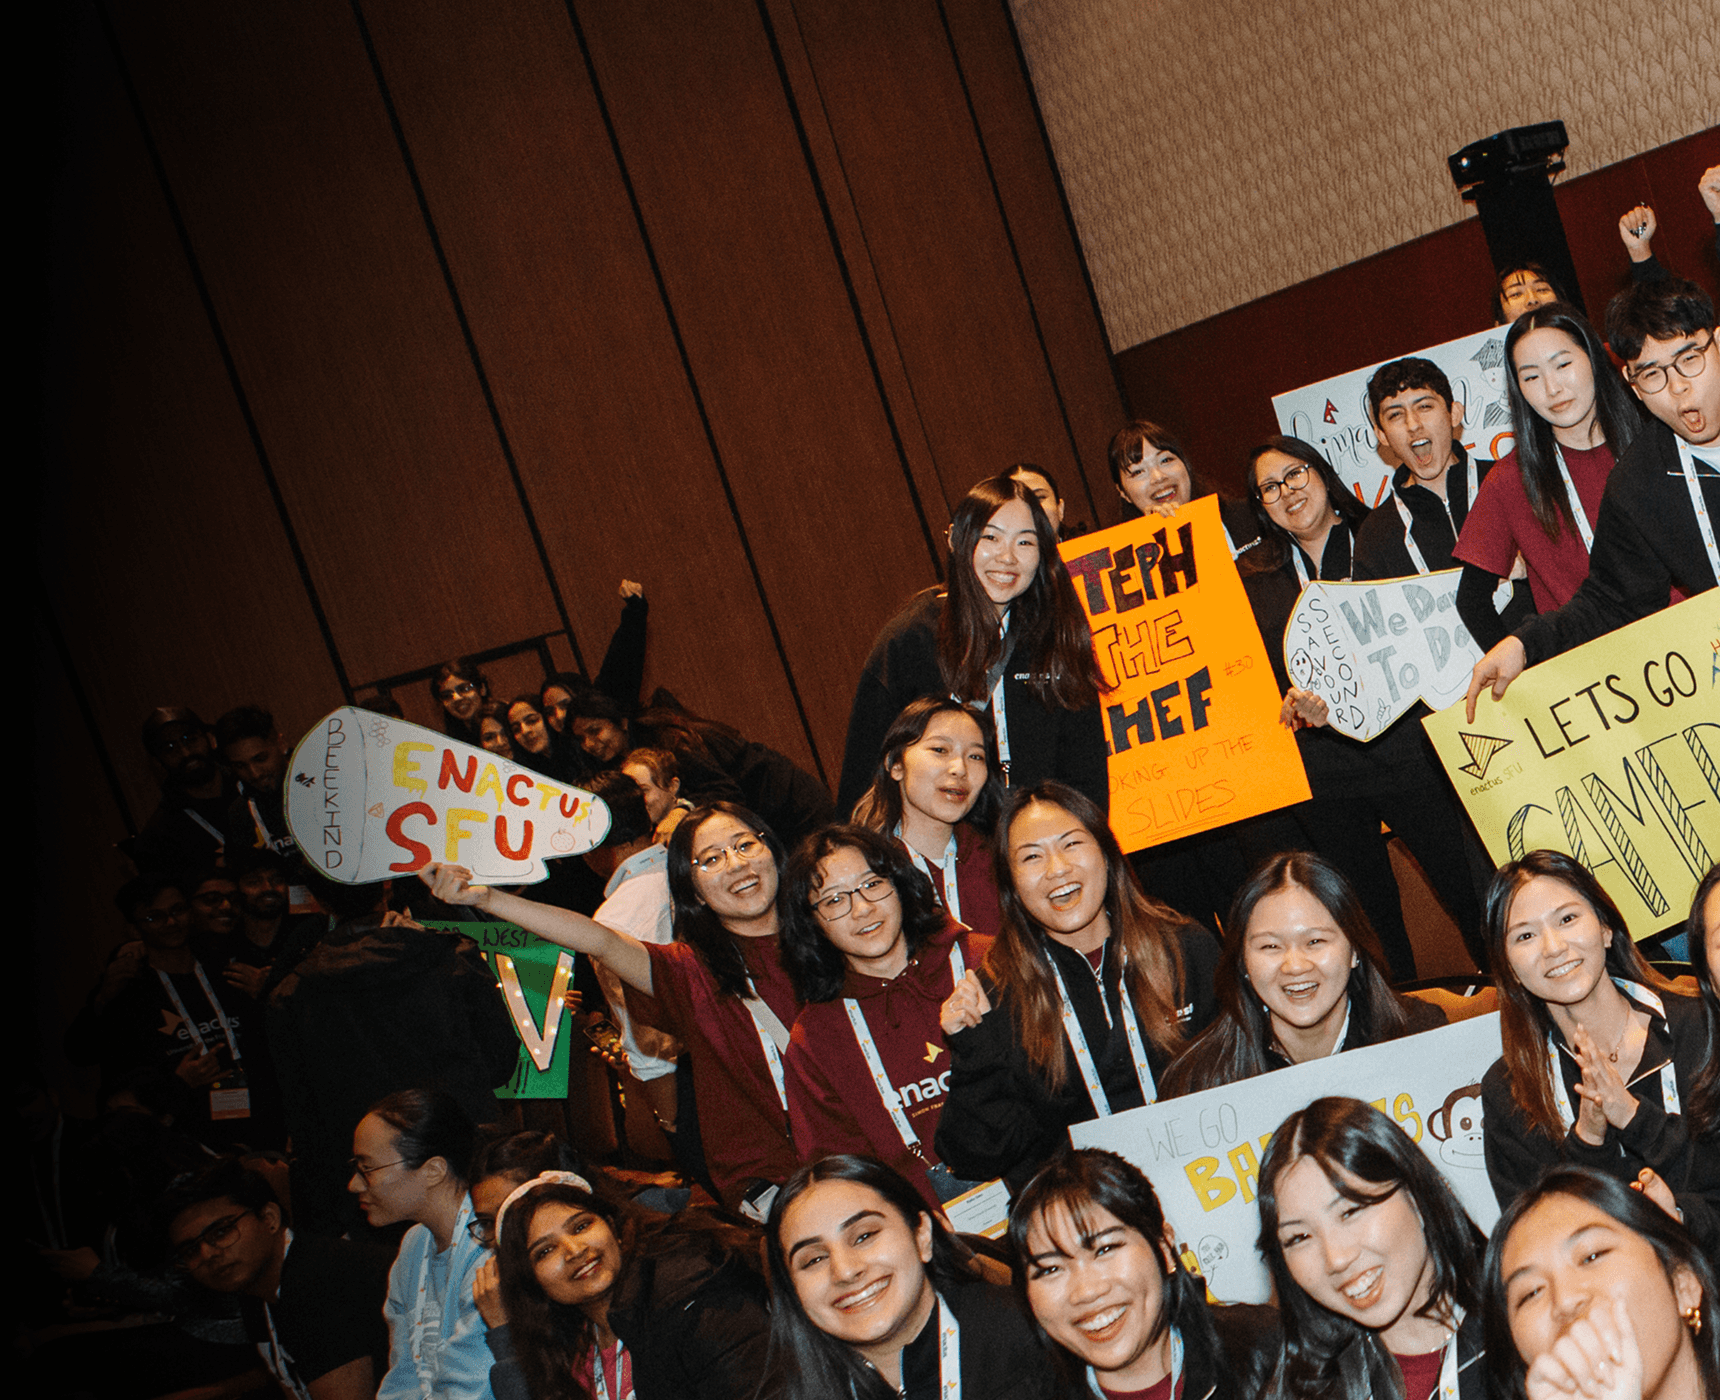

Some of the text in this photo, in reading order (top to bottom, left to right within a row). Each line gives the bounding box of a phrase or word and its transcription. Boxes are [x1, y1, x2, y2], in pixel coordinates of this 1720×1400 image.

[1066, 522, 1199, 616] TEPH
[1339, 584, 1457, 647] We Dar
[1092, 609, 1195, 696] THE
[1223, 655, 1253, 678] #30
[1308, 598, 1365, 730] SECOND
[1367, 645, 1420, 703] To
[1106, 666, 1213, 756] HEF
[1524, 651, 1698, 759] LETS GO
[393, 741, 591, 828] ENACTUS
[1110, 733, 1254, 795] OKING UP THE
[1470, 775, 1503, 796] enactus
[386, 801, 534, 872] SFU
[1127, 778, 1237, 837] SLIDES
[482, 927, 529, 947] WEST
[481, 950, 575, 1074] V
[1147, 1103, 1238, 1162] WE GO
